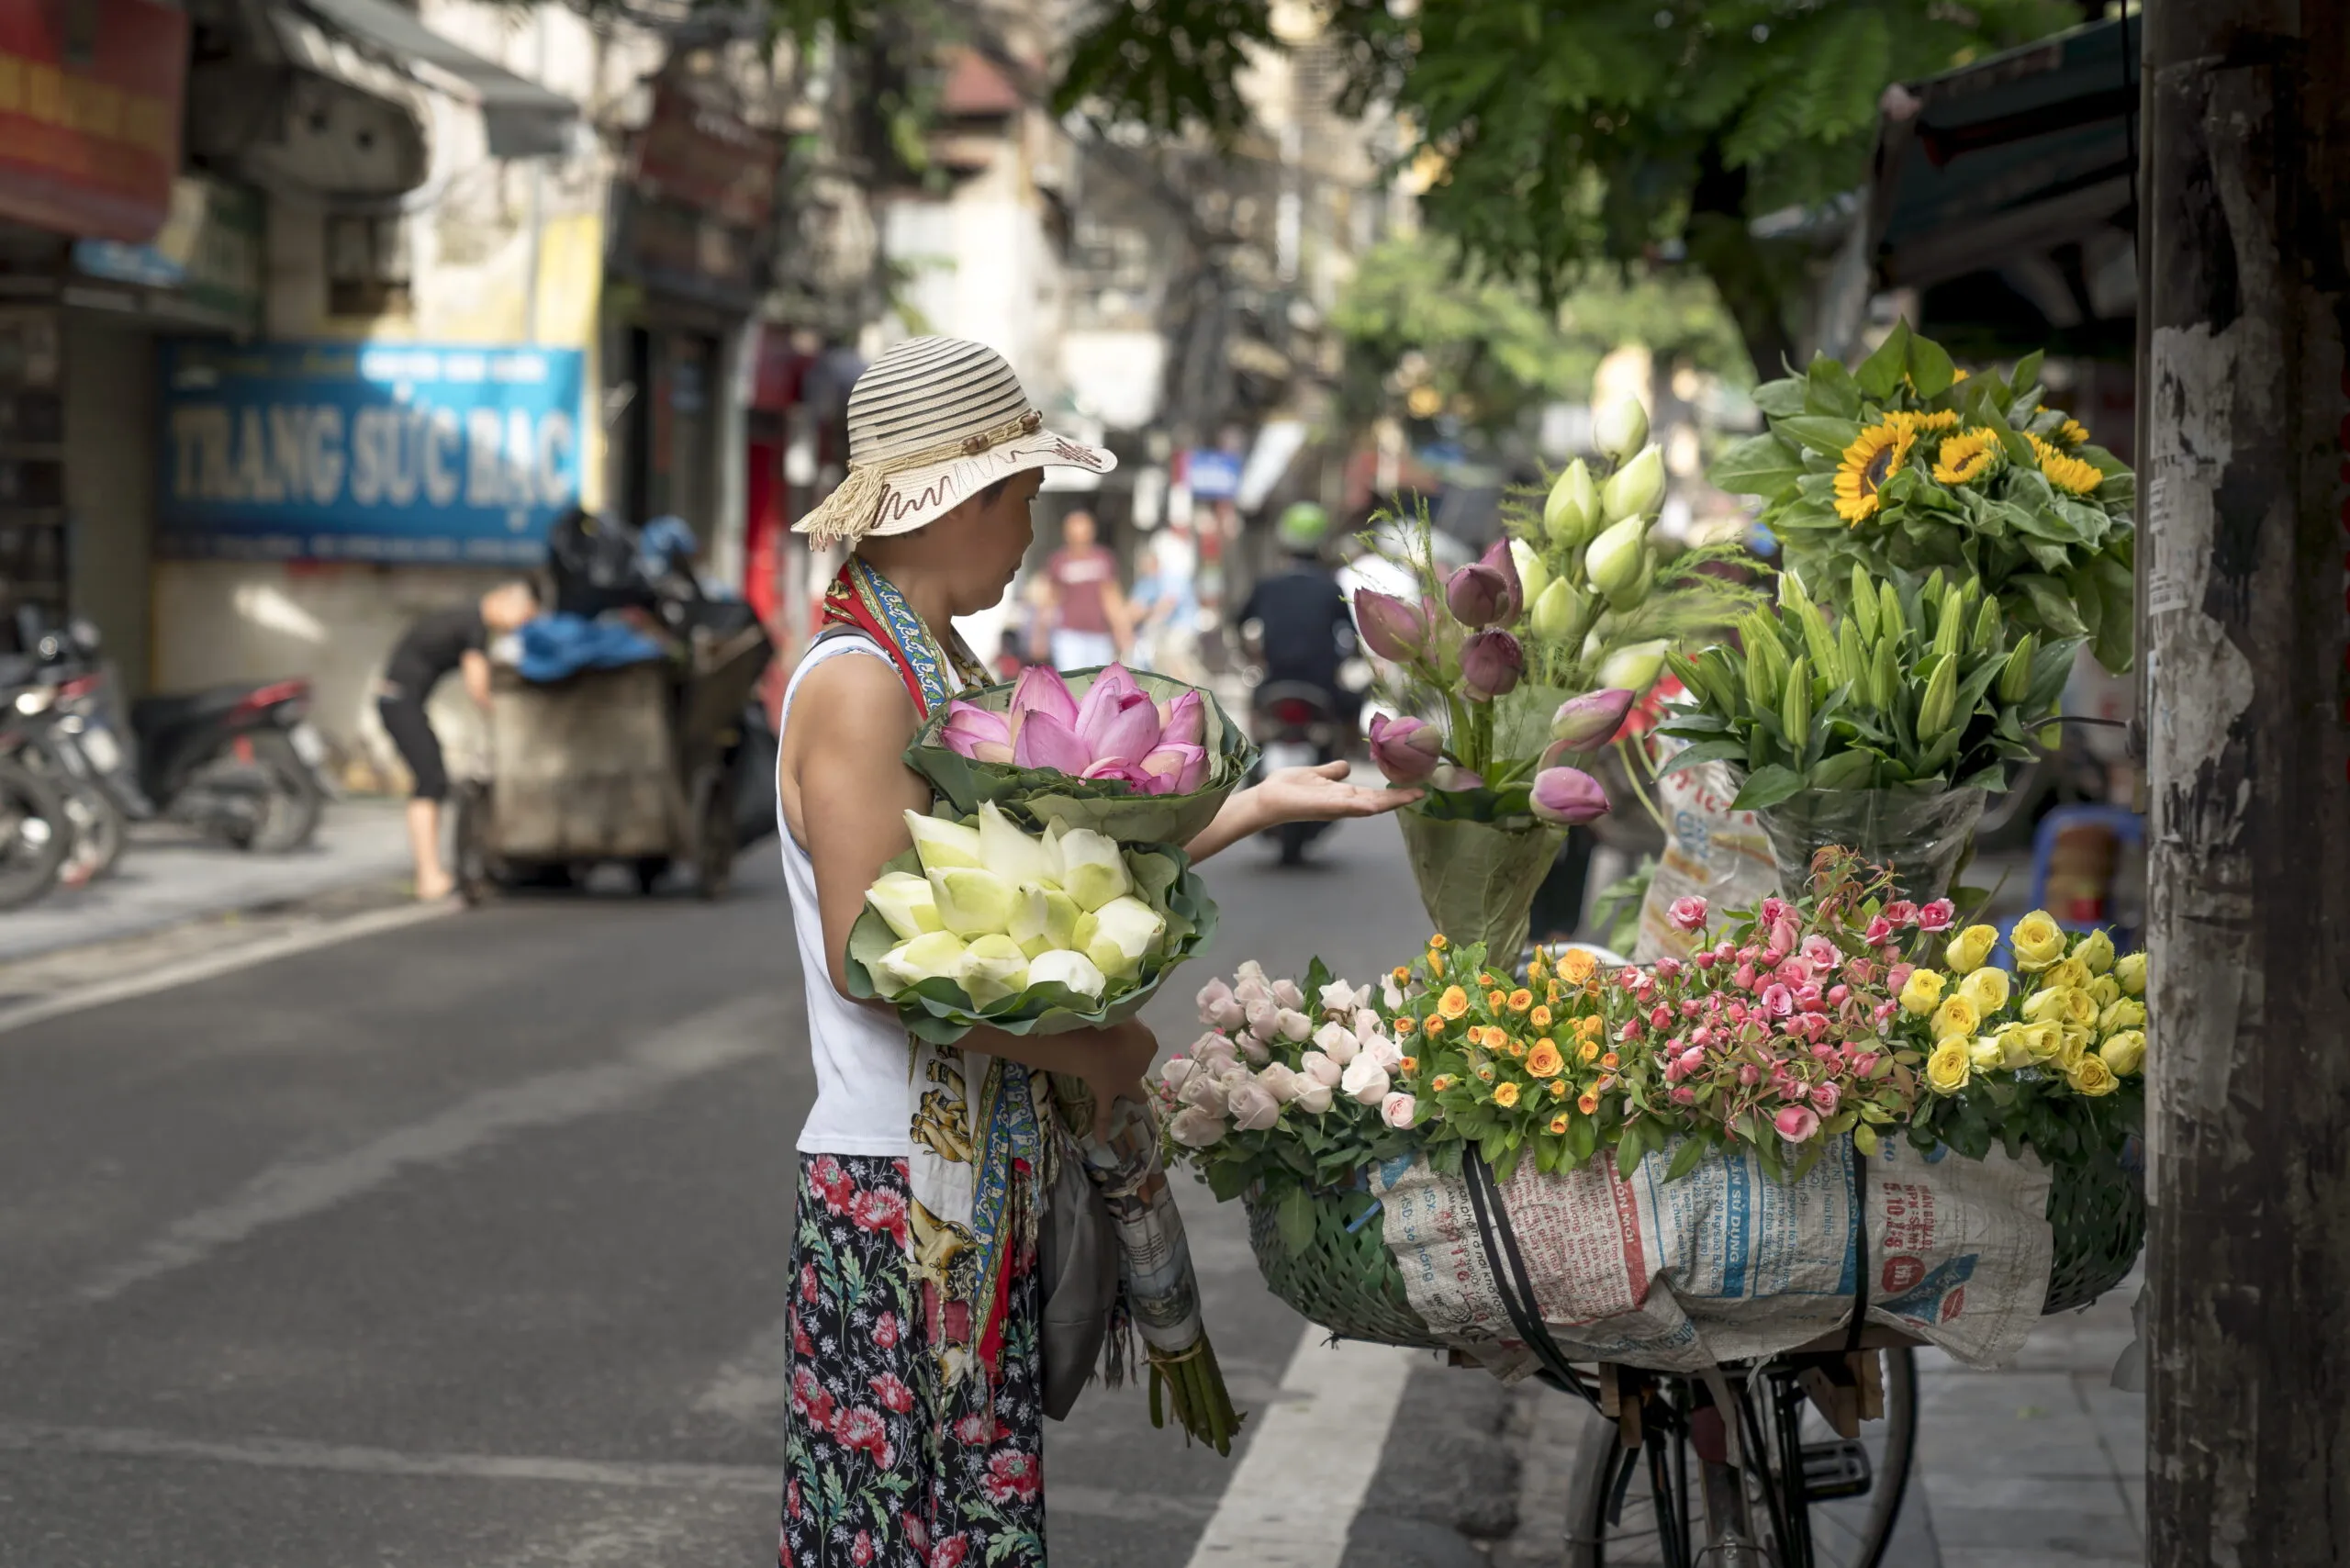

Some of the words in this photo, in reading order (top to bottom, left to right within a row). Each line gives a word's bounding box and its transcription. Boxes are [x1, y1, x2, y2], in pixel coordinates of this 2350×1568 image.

[173, 405, 344, 506] TRANG
[1714, 1180, 1723, 1190] 15
[1714, 1199, 1724, 1212] 20
[1622, 1213, 1634, 1243] MỚI
[1724, 1215, 1740, 1262] DỤNG
